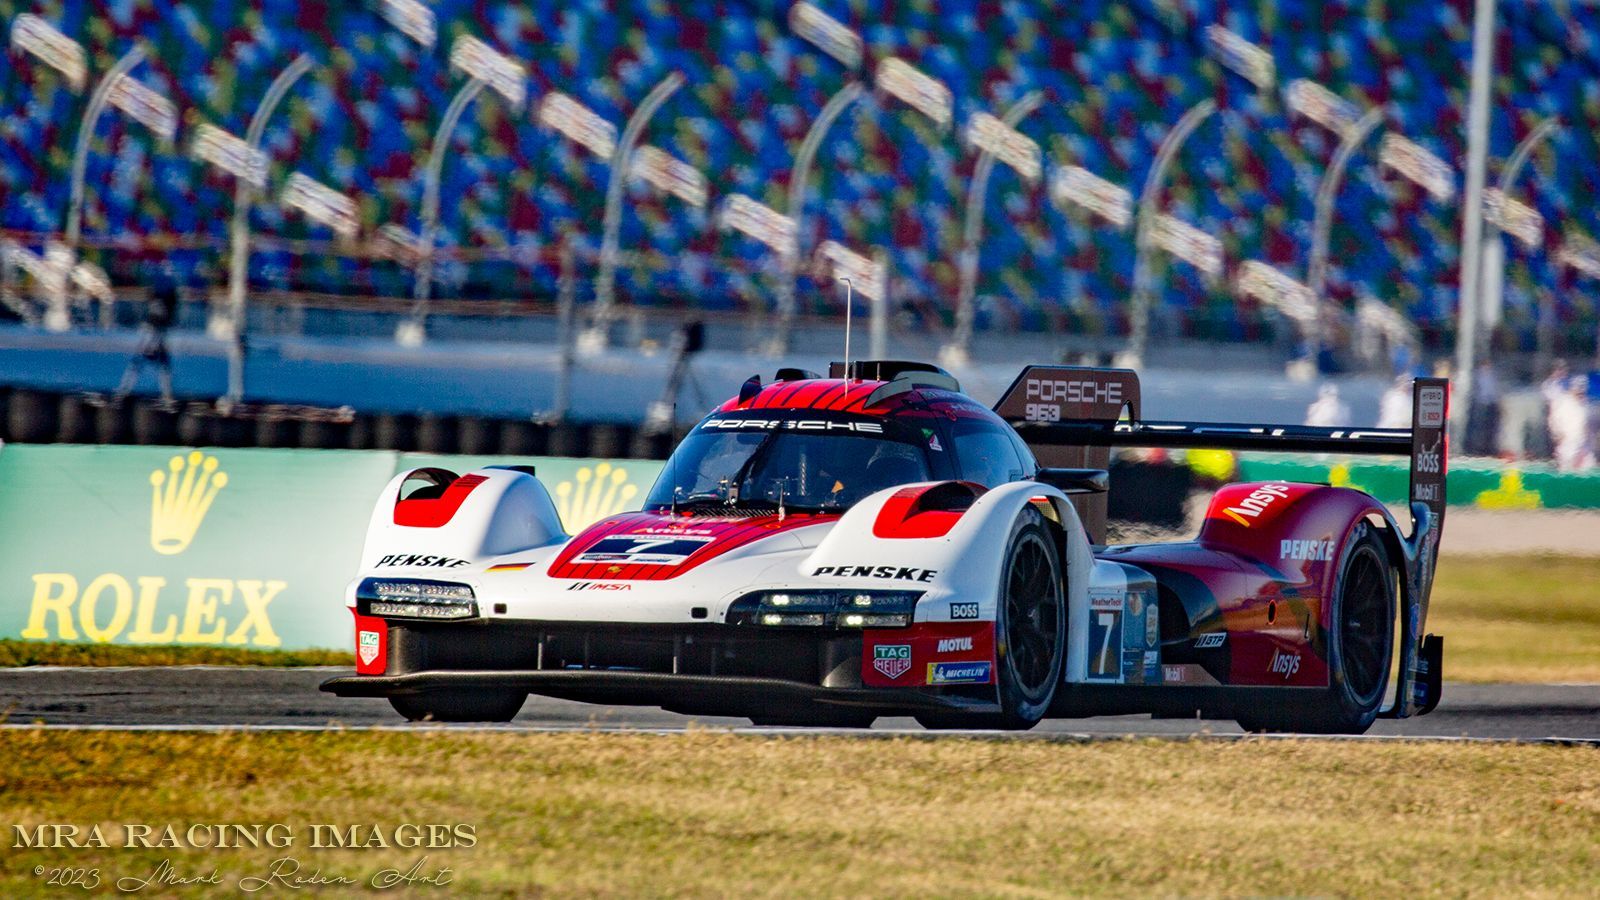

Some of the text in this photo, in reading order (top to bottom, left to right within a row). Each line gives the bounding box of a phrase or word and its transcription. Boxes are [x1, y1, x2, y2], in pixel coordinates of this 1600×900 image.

[1026, 379, 1122, 404] PORSCHE
[1025, 403, 1060, 421] 963
[701, 419, 883, 433] PORSCHE
[1417, 453, 1439, 473] BOSS
[1415, 483, 1433, 500] Mobil
[1222, 483, 1289, 528] Ansys
[625, 539, 675, 554] 7
[1280, 539, 1335, 561] PENSKE
[374, 554, 471, 569] PENSKE
[811, 566, 938, 583] PENSKE
[588, 583, 632, 591] IMSA
[20, 572, 288, 647] ROLEX
[952, 604, 978, 617] BOSS
[360, 633, 378, 645] TAG
[937, 638, 973, 652] MOTUL
[1098, 613, 1114, 675] 7
[877, 647, 908, 658] TAG
[874, 659, 910, 676] HEUER
[945, 667, 986, 678] MICHELIN
[1267, 648, 1301, 680] Ansys
